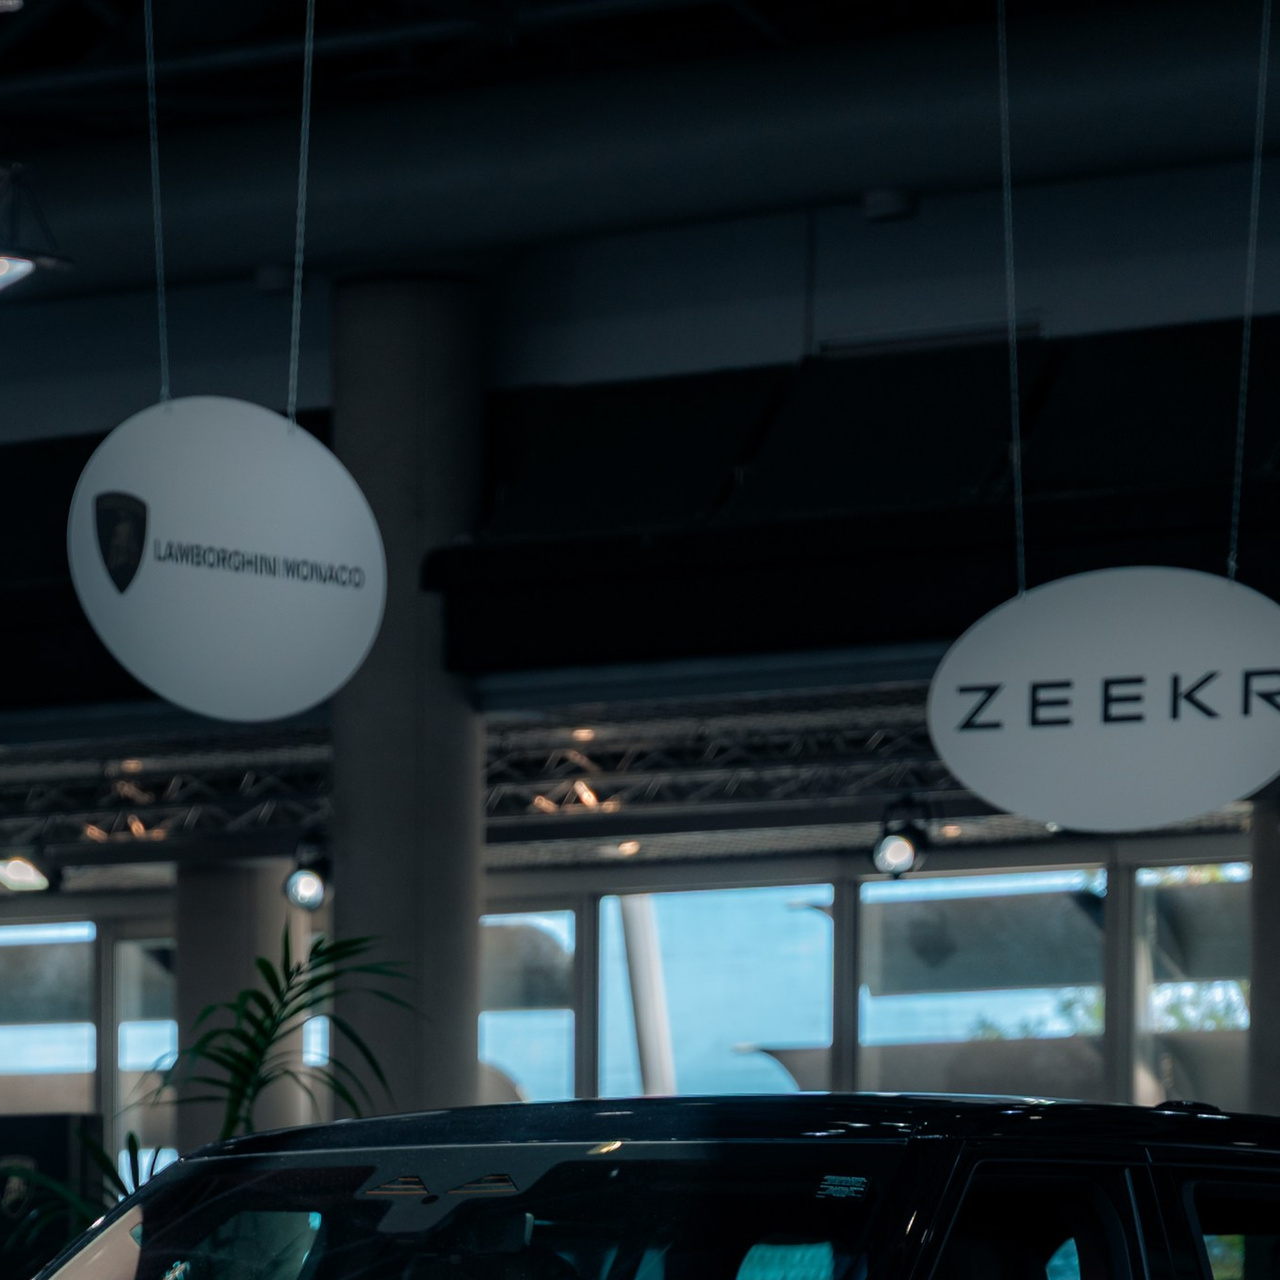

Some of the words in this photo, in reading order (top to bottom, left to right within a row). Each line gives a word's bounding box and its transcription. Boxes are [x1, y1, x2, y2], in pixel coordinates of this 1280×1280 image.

[154, 540, 280, 577] LAMBORGHINI
[282, 558, 365, 588] MONACO
[958, 669, 1280, 730] ZEEKR
